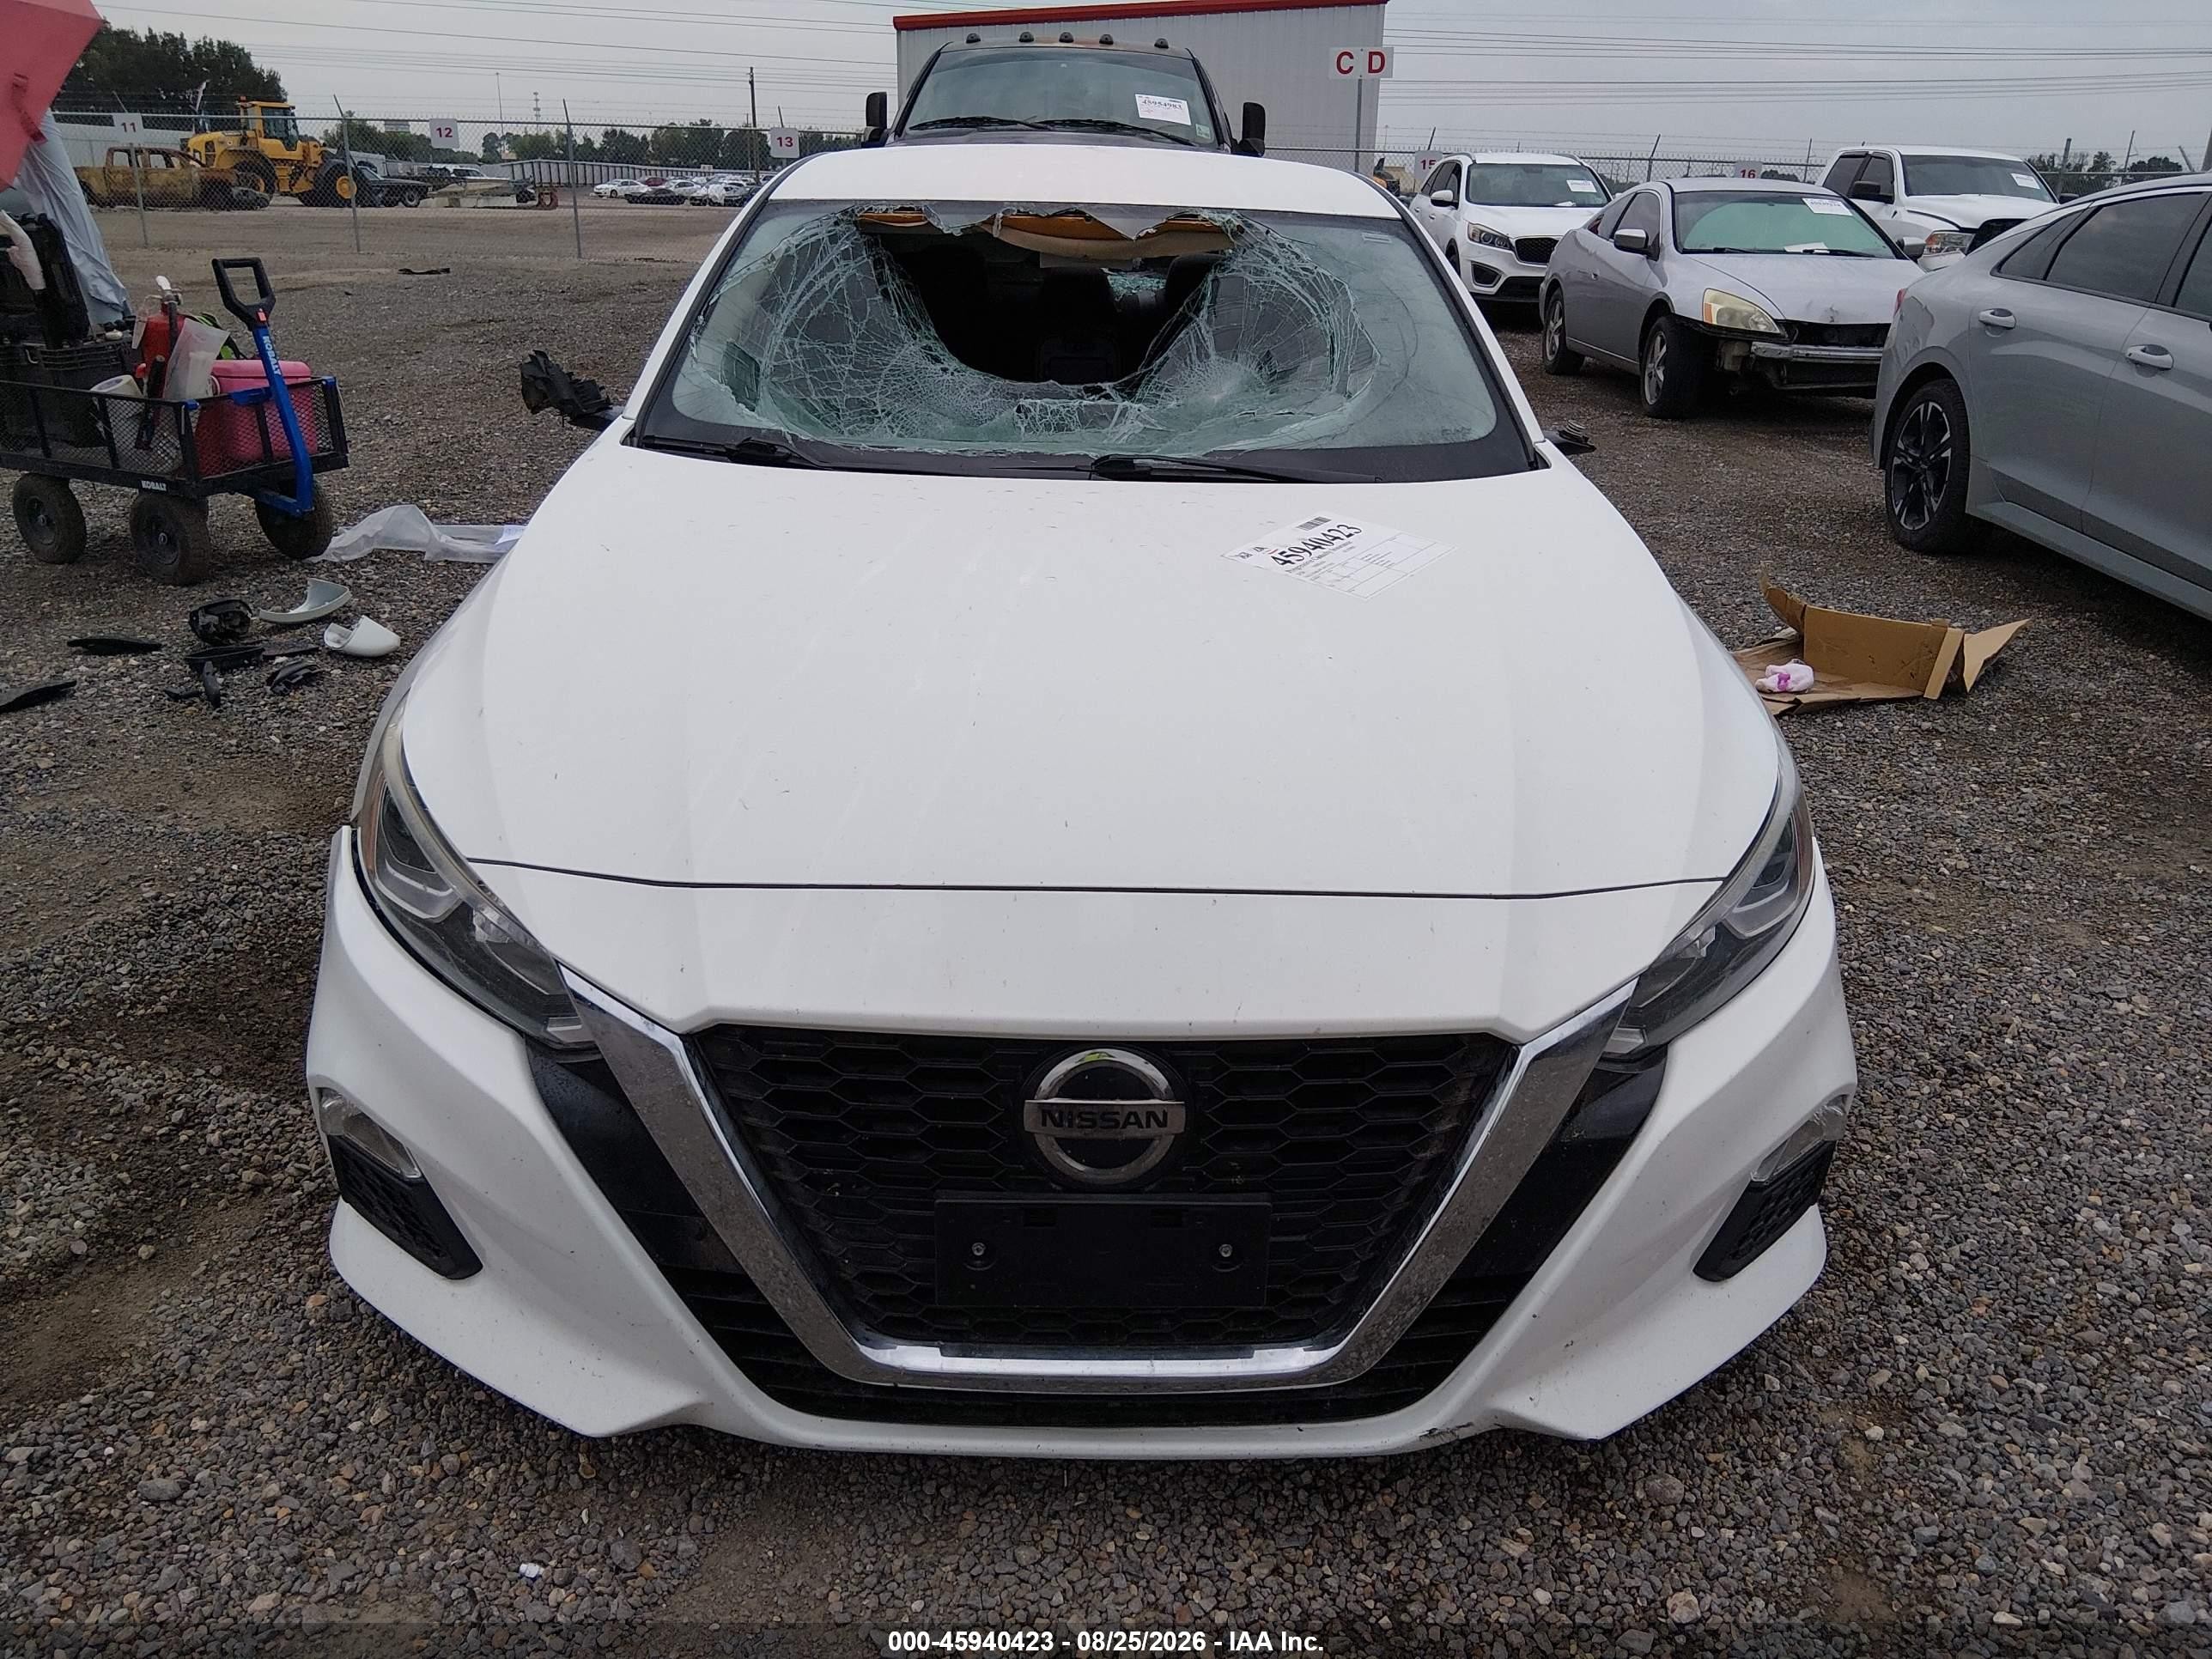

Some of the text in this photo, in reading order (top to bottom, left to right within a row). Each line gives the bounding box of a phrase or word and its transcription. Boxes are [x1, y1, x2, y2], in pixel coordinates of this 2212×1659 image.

[1336, 51, 1386, 75] C D
[121, 122, 137, 133] 11
[435, 126, 453, 138] 12
[776, 137, 793, 148] 13
[1740, 168, 1756, 179] 16
[262, 336, 283, 375] KOBALT
[1270, 524, 1362, 566] 45940423
[1041, 1109, 1169, 1129] NISSAN
